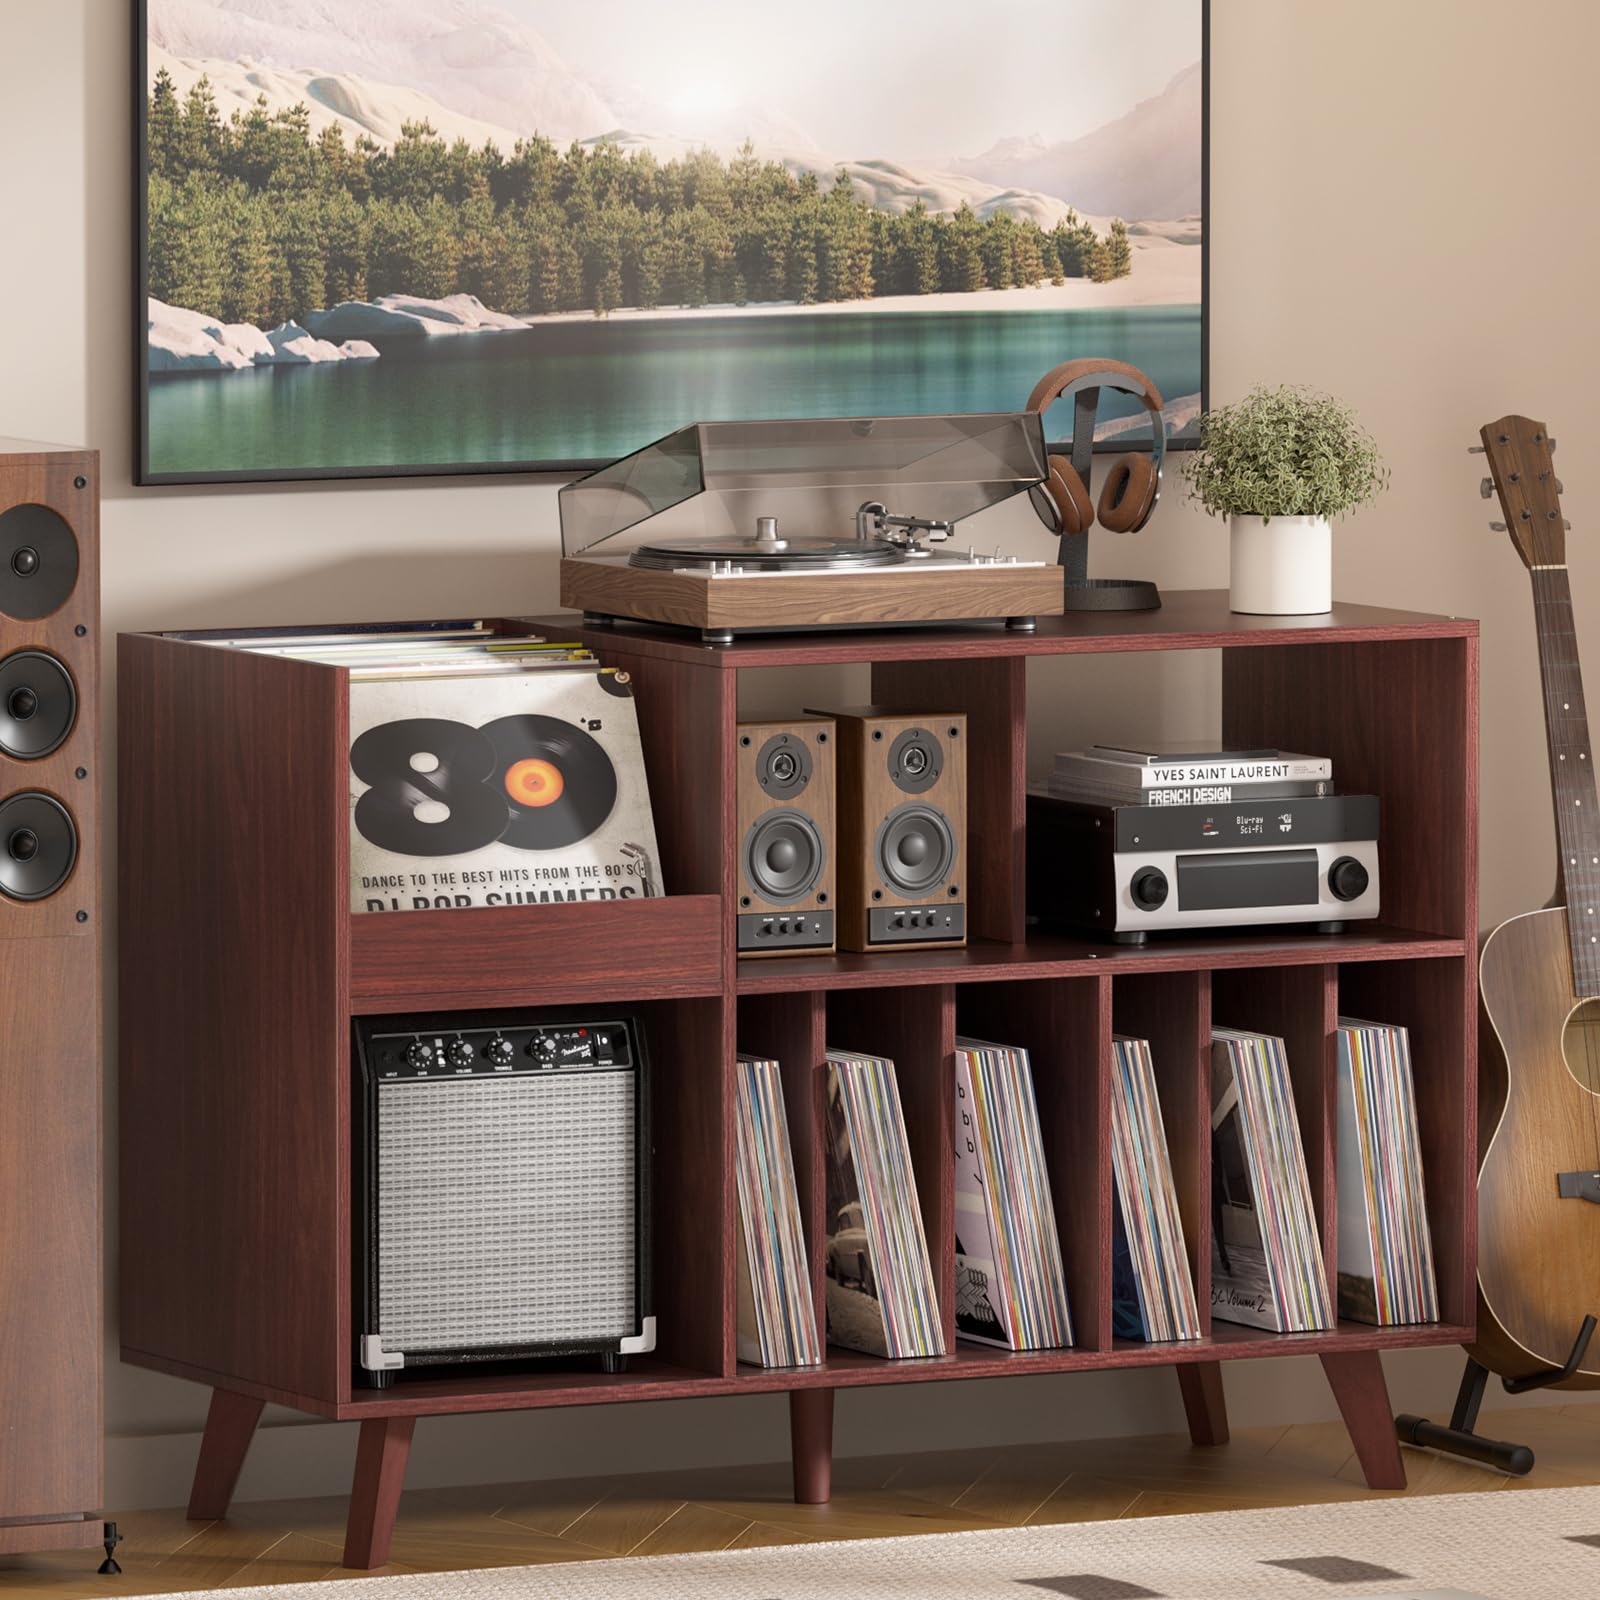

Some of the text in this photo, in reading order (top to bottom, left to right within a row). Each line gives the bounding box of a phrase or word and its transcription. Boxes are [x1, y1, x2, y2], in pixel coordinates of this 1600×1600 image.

[1153, 768, 1184, 782] YVES
[1189, 767, 1227, 781] SAINT
[1231, 765, 1290, 779] LAURENT
[1148, 786, 1232, 805] FRENCH DESIGN
[1236, 816, 1264, 825] Blu-ray
[1240, 825, 1264, 834] Sci-Fi
[362, 864, 634, 888] DANCE TO THE BEST HITS FROM THE 80'S
